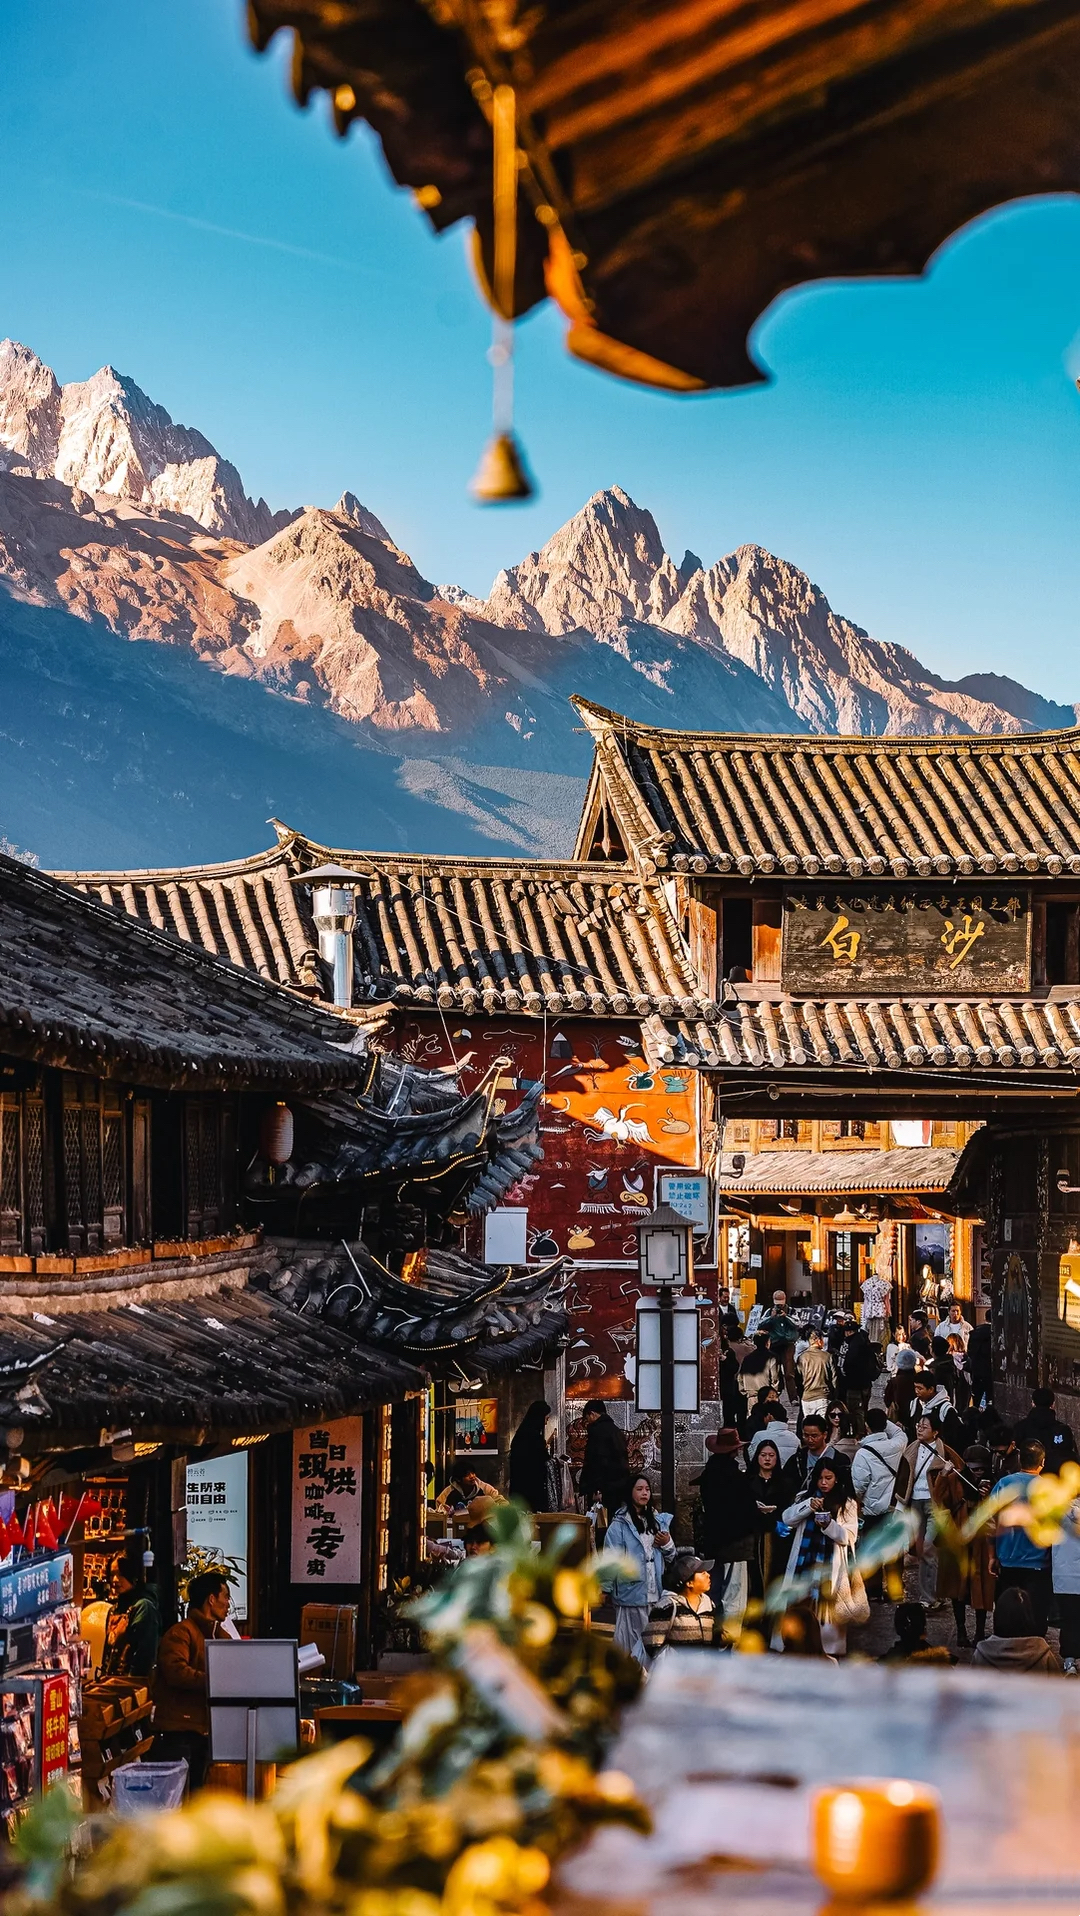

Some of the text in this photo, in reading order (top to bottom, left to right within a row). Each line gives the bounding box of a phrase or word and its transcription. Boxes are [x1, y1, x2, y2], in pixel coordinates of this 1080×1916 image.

[819, 915, 986, 969] 白沙
[187, 1482, 226, 1492] 生所求
[49, 1688, 63, 1711] 雪山
